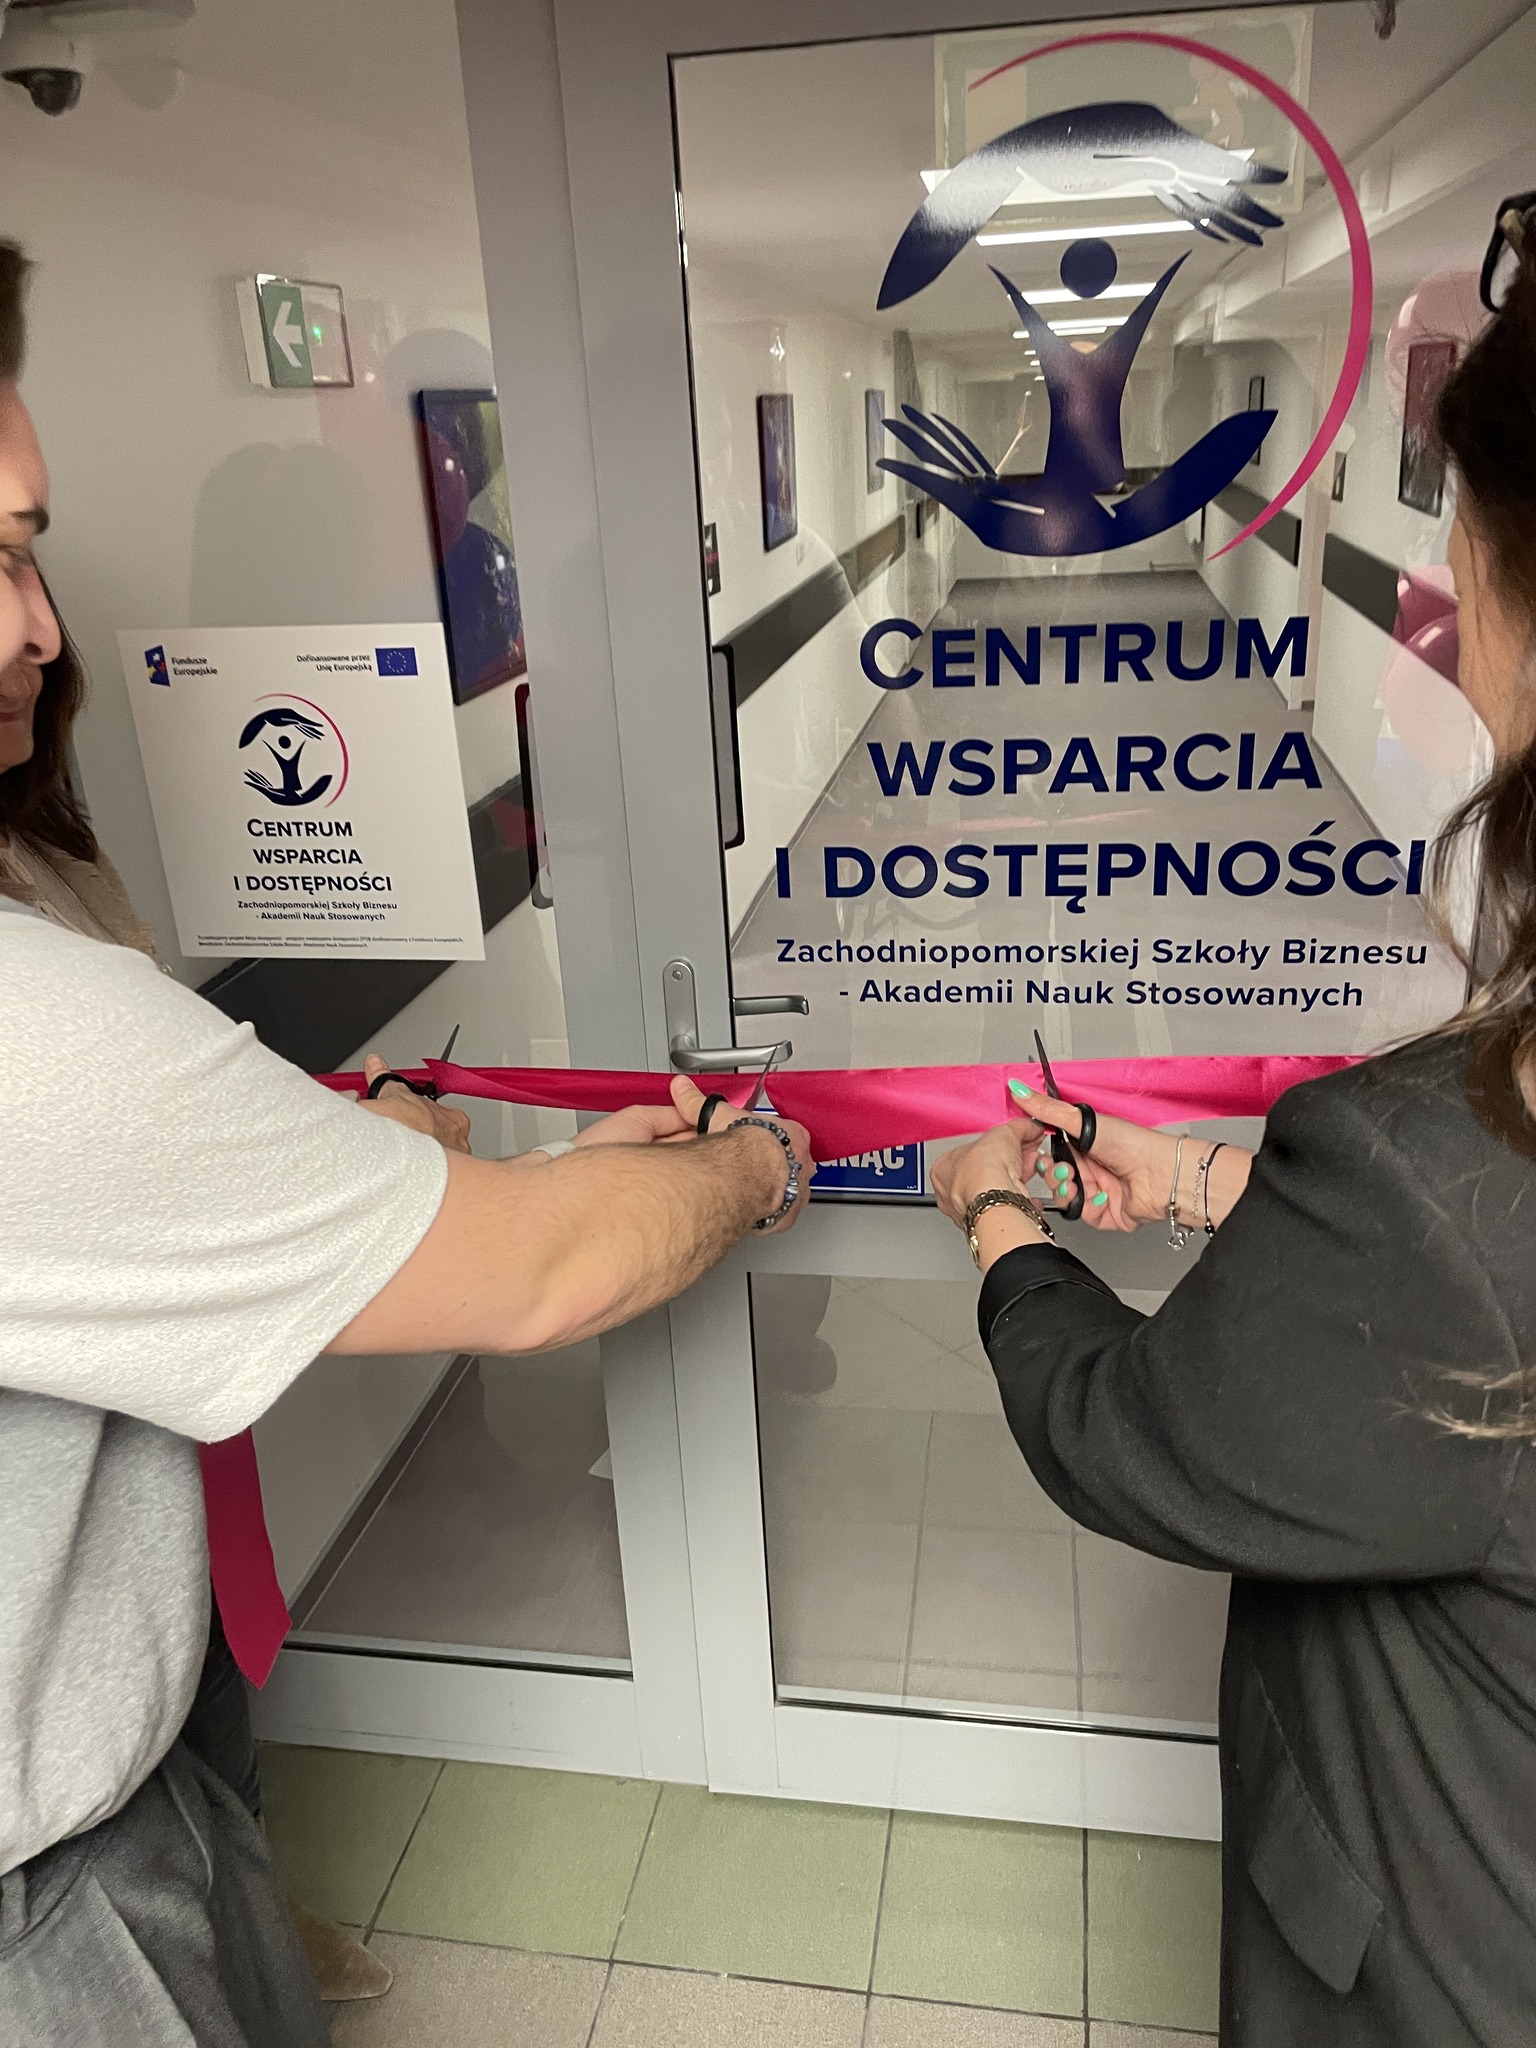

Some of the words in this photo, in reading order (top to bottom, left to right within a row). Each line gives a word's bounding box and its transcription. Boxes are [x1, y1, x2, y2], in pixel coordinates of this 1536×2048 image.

[171, 656, 208, 666] Fundusze
[296, 653, 350, 663] Dofinansowane
[351, 655, 370, 663] przez
[859, 616, 1310, 690] CENTRUM
[173, 666, 218, 677] Europejskie
[866, 731, 1323, 797] WSPARCIA
[246, 818, 353, 837] CENTRUM
[252, 848, 363, 864] WSPARCIA
[775, 847, 791, 899] I
[823, 820, 1426, 914] DOSTĘPNOŚCI
[233, 875, 241, 891] I
[245, 871, 392, 896] DOSTĘPNOŚCI
[238, 900, 330, 911] Zachodniopomorskiej
[331, 900, 361, 911] Szkoły
[362, 901, 398, 910] Biznesu
[260, 911, 302, 920] Akademii
[302, 912, 326, 920] Nauk
[327, 912, 386, 922] Stosowanych
[776, 937, 1140, 970] Zachodniopomorskiej
[1152, 938, 1271, 971] Szkoły
[1282, 937, 1427, 966] Biznesu
[859, 978, 1014, 1004] Akademii
[1026, 979, 1115, 1006] Nauk
[1125, 980, 1364, 1013] Stosowanych
